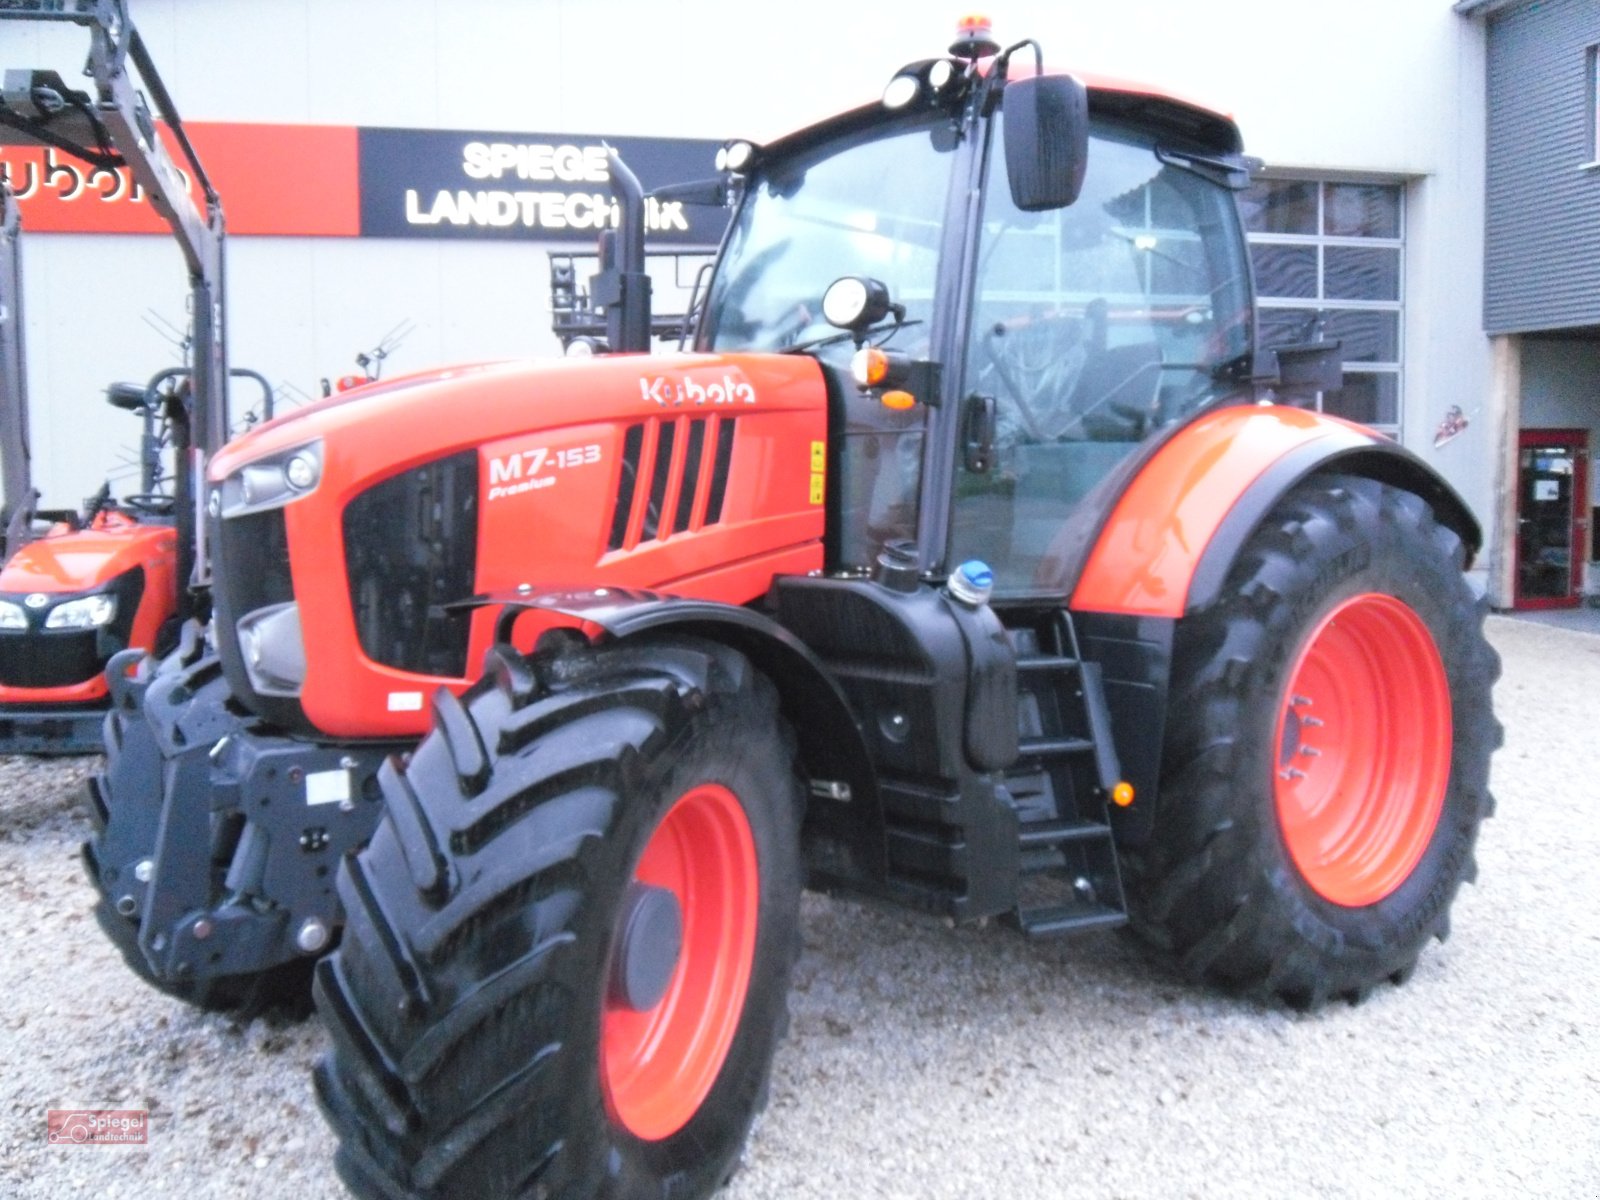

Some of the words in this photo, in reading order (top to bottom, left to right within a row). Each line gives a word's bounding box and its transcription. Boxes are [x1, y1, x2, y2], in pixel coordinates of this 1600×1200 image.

[462, 141, 618, 182] SPIEGE
[405, 189, 689, 231] LANDTECHIK
[639, 374, 756, 407] Kubota
[489, 444, 602, 485] M7-153
[488, 475, 557, 501] Premium
